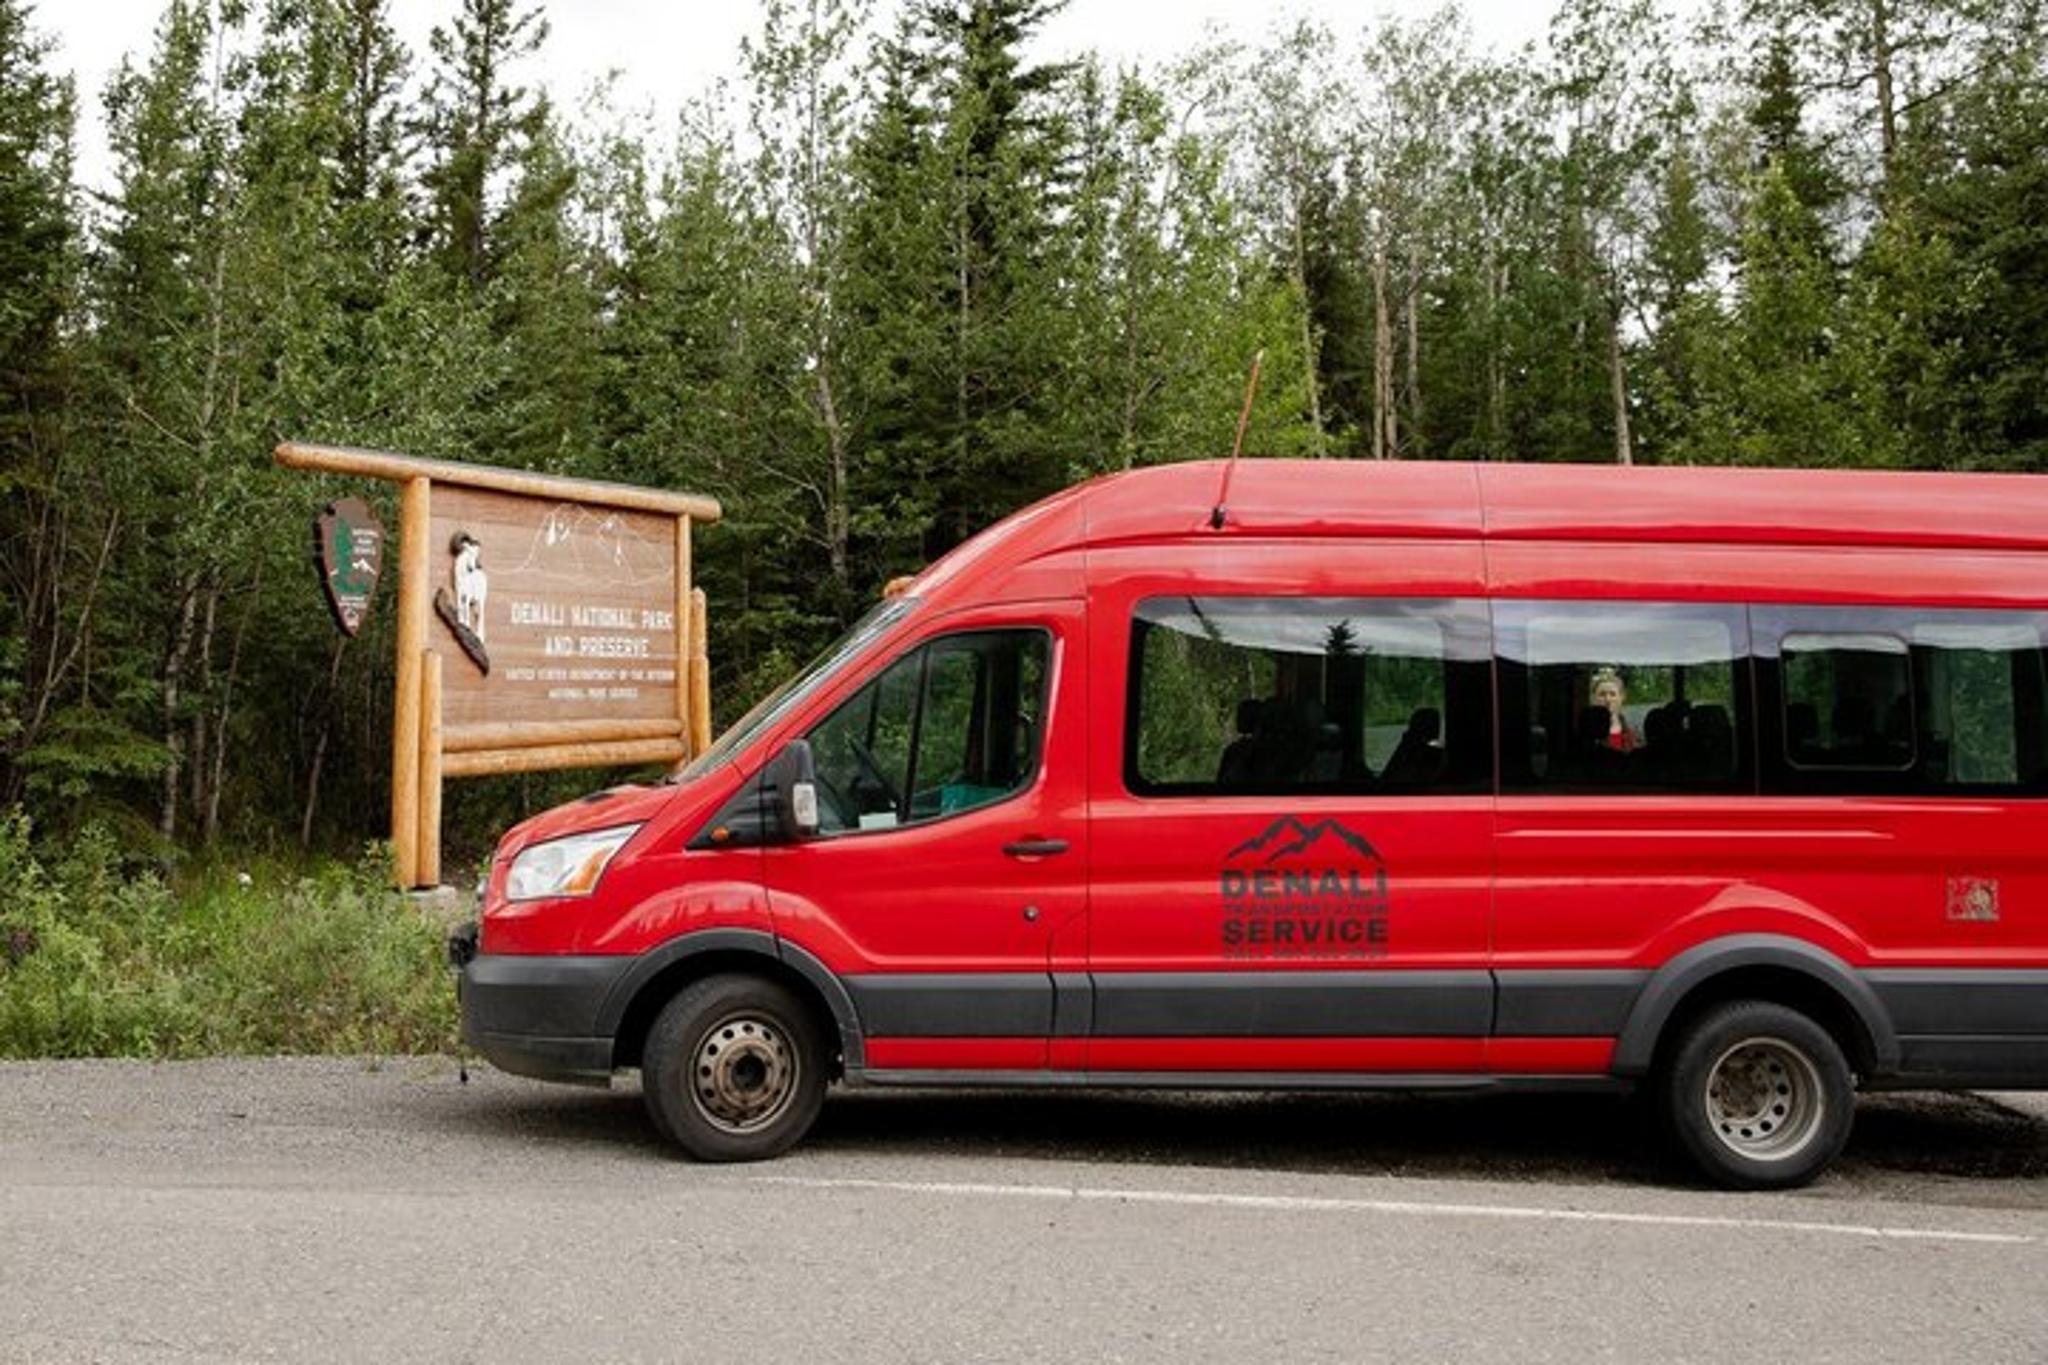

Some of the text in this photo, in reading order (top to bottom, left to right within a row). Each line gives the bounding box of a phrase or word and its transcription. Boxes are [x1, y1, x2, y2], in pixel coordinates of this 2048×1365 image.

[511, 602, 673, 630] DENALI NATIONAL PARK
[545, 635, 649, 658] AND PRESERVE
[1221, 868, 1388, 899] DENALI
[1222, 918, 1389, 944] SERVICE
